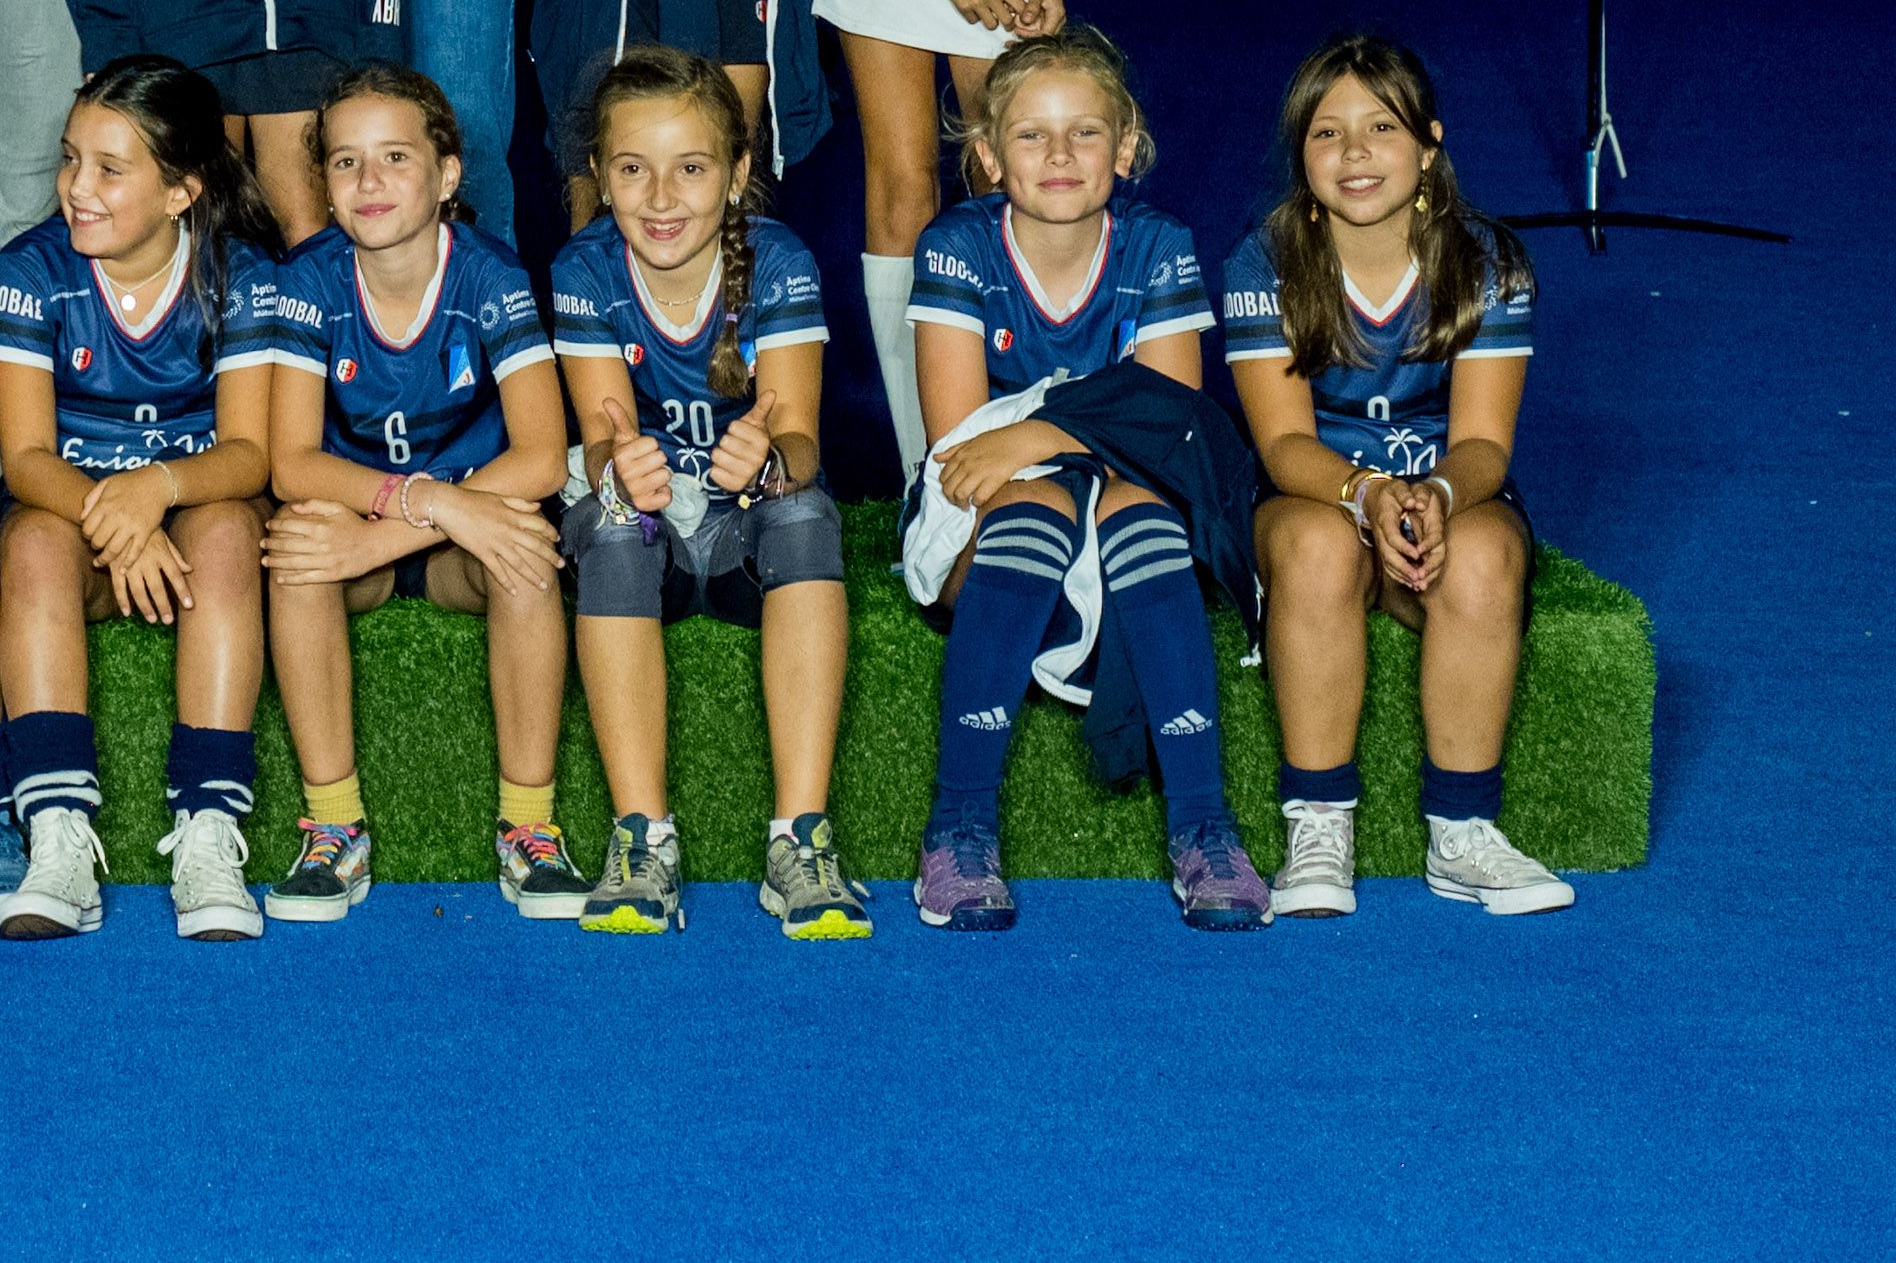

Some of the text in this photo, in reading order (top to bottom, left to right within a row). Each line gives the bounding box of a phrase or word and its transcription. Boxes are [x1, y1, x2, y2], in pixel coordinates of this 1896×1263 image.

[928, 251, 984, 288] GLOO
[384, 410, 412, 465] 6
[661, 398, 715, 447] 20
[958, 716, 1012, 731] adidas
[1160, 719, 1213, 736] adidas
